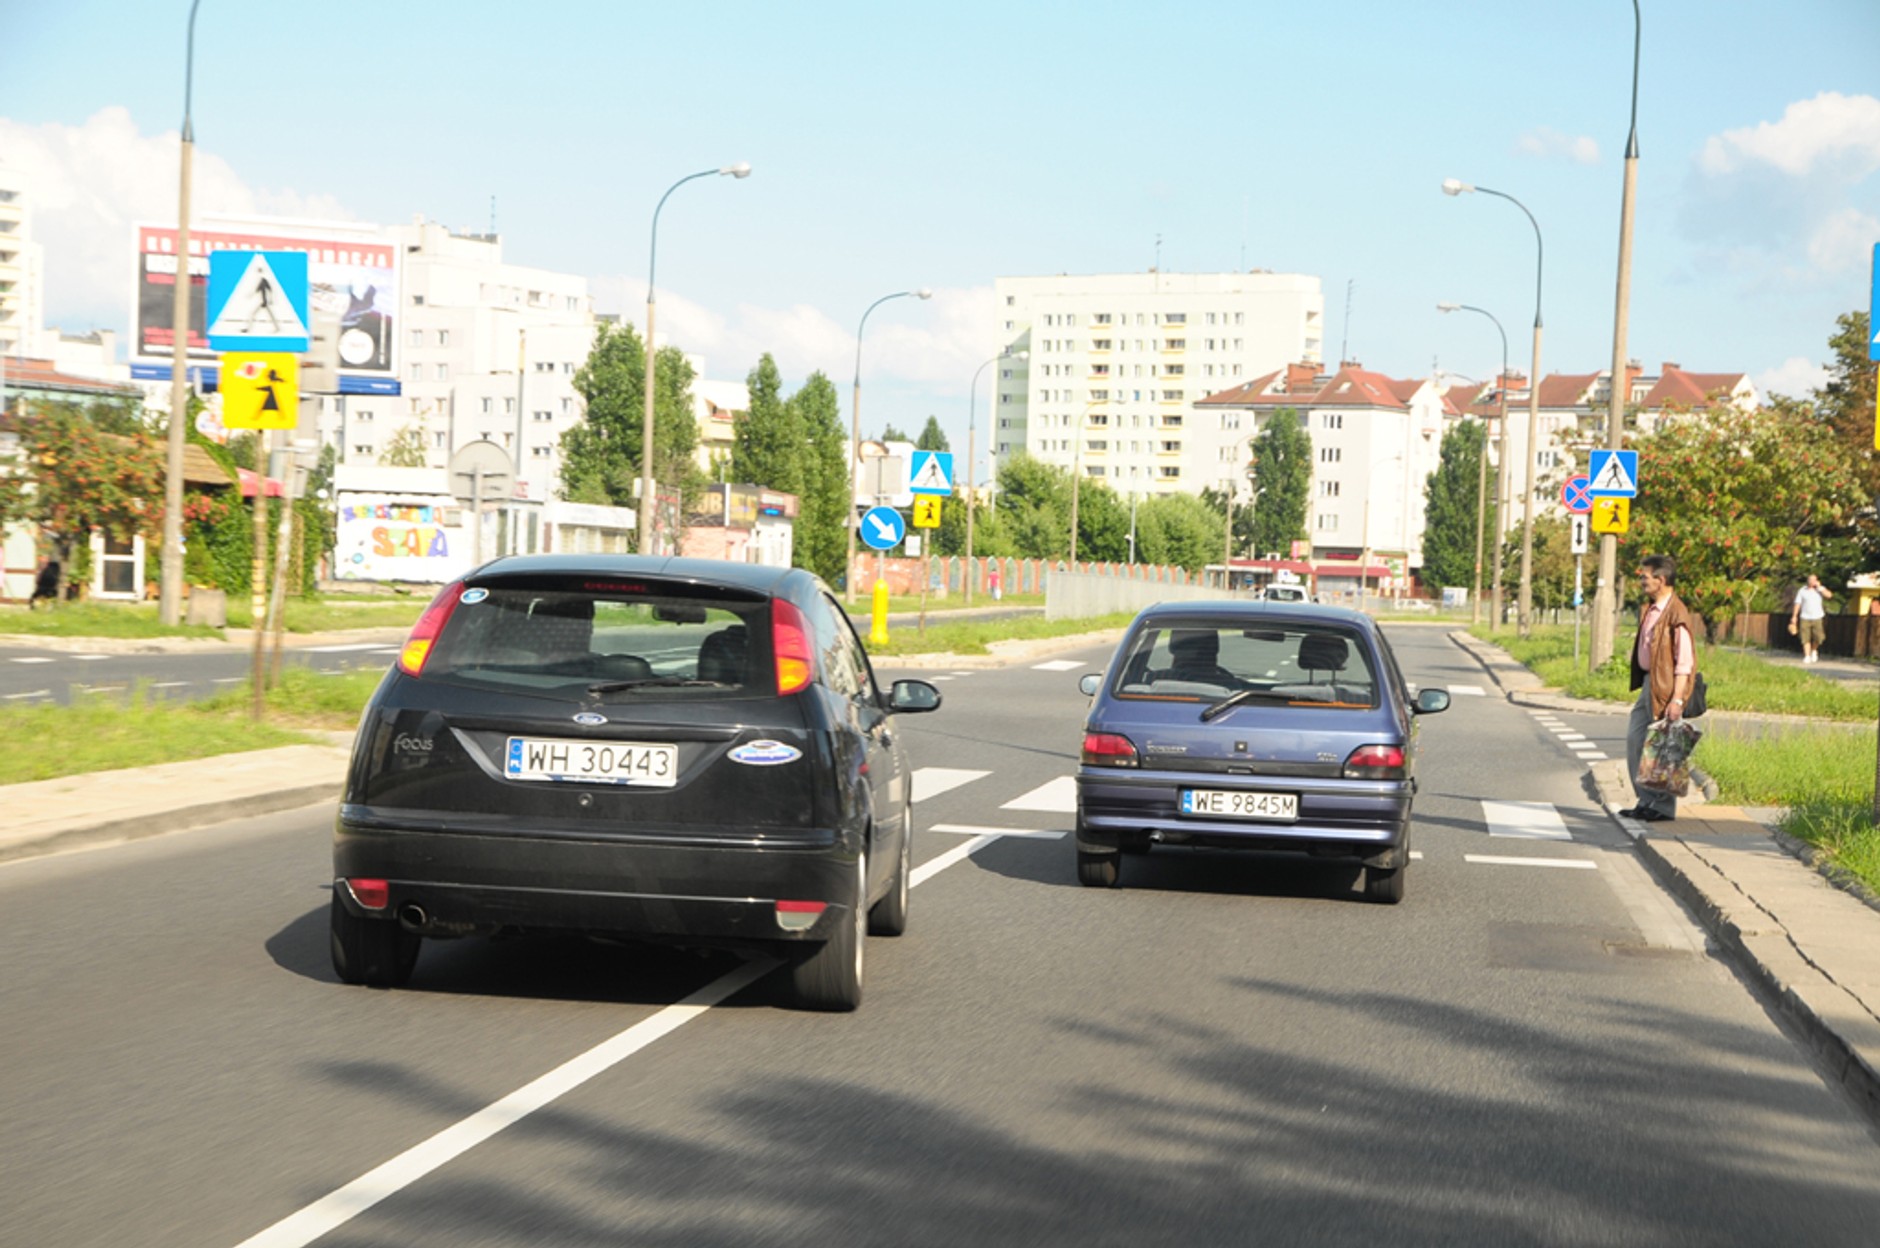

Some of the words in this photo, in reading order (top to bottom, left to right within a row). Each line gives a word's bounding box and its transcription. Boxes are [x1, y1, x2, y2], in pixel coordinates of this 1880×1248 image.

[528, 744, 569, 771] WH
[580, 746, 670, 776] 30443
[1195, 792, 1224, 812] WE
[1231, 794, 1295, 815] 9845M
